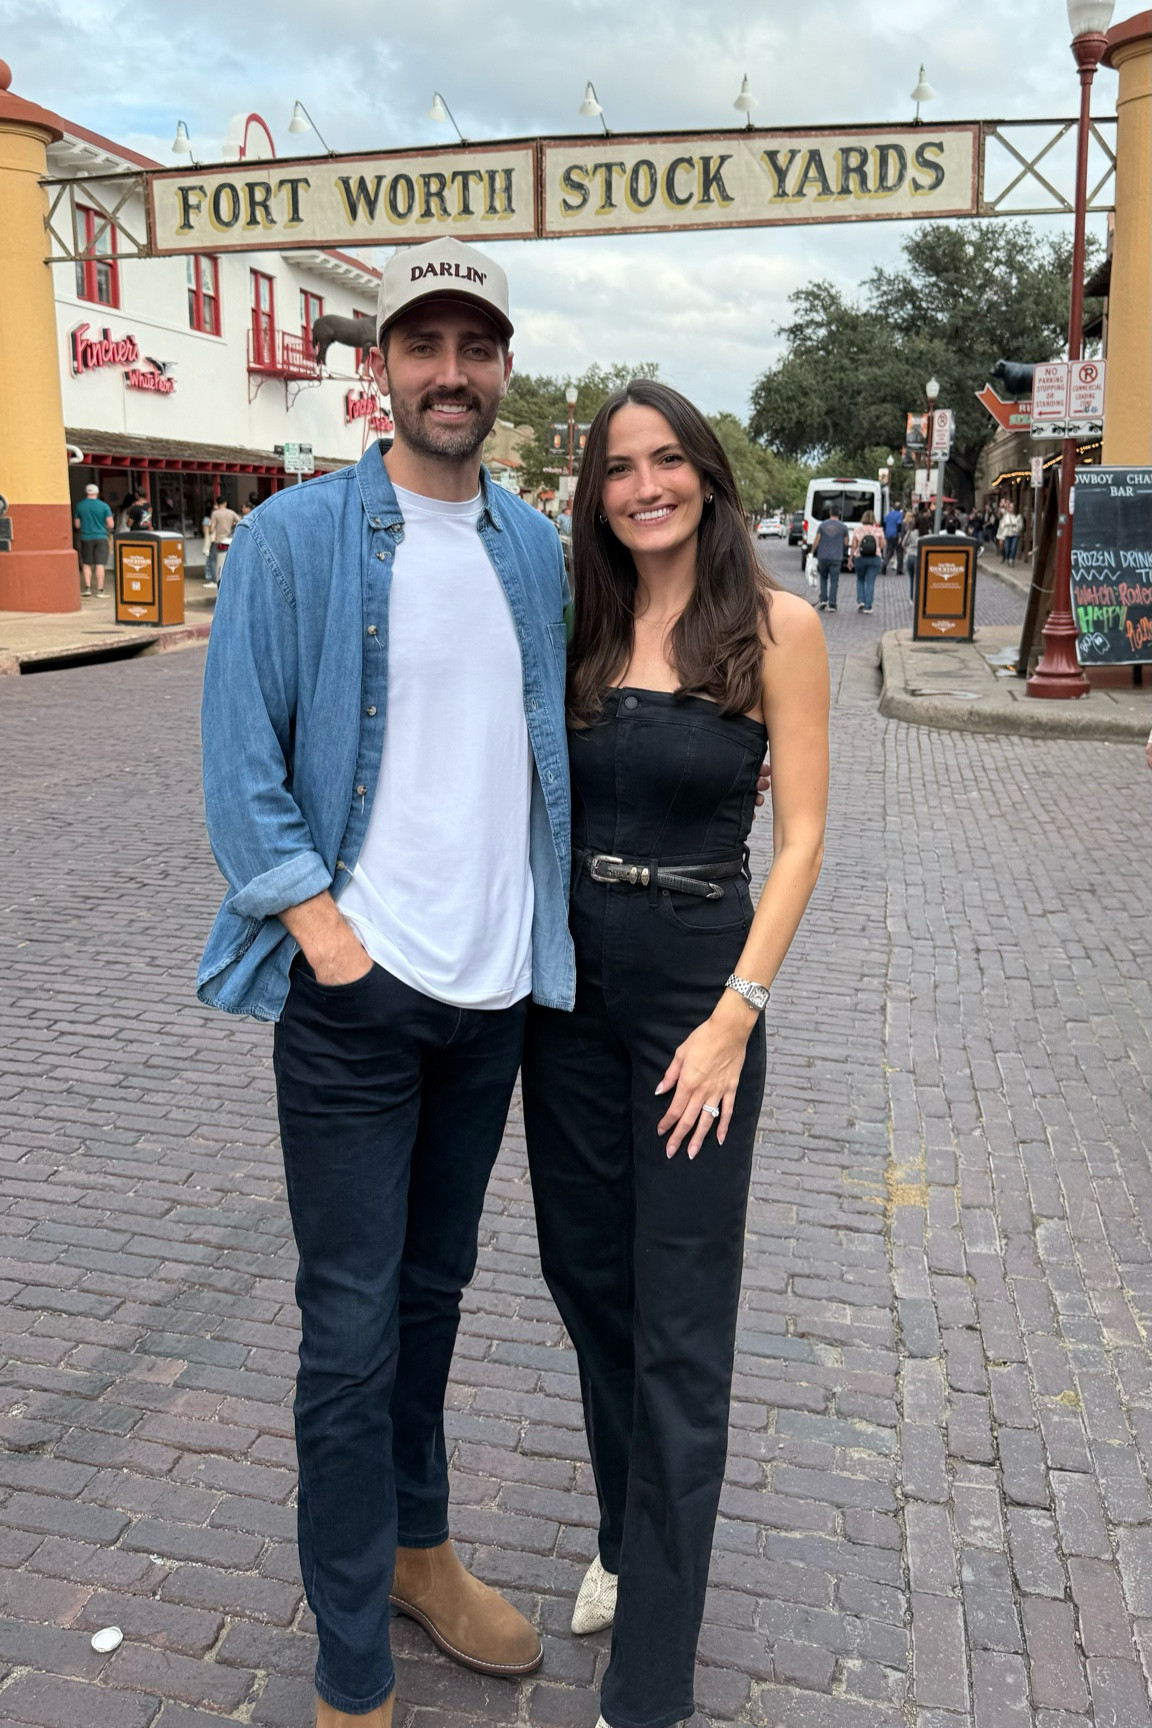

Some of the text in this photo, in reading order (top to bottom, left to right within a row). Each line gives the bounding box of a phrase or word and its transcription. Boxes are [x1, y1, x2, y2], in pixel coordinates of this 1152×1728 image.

[176, 141, 946, 234] FORT WORTH STOCK YARDS
[410, 262, 487, 286] DARLIN'
[71, 322, 139, 374] Fincher's
[1044, 367, 1058, 376] NO
[1038, 376, 1064, 384] PARKING
[1036, 384, 1065, 393] STOPPING
[1072, 384, 1101, 392] COMMERCIAL
[1075, 392, 1096, 400] LOADING
[1036, 400, 1064, 408] STANDING
[1074, 473, 1152, 485] OWBOY CHA
[1110, 486, 1134, 497] BAR
[1070, 549, 1116, 568] FROZEN
